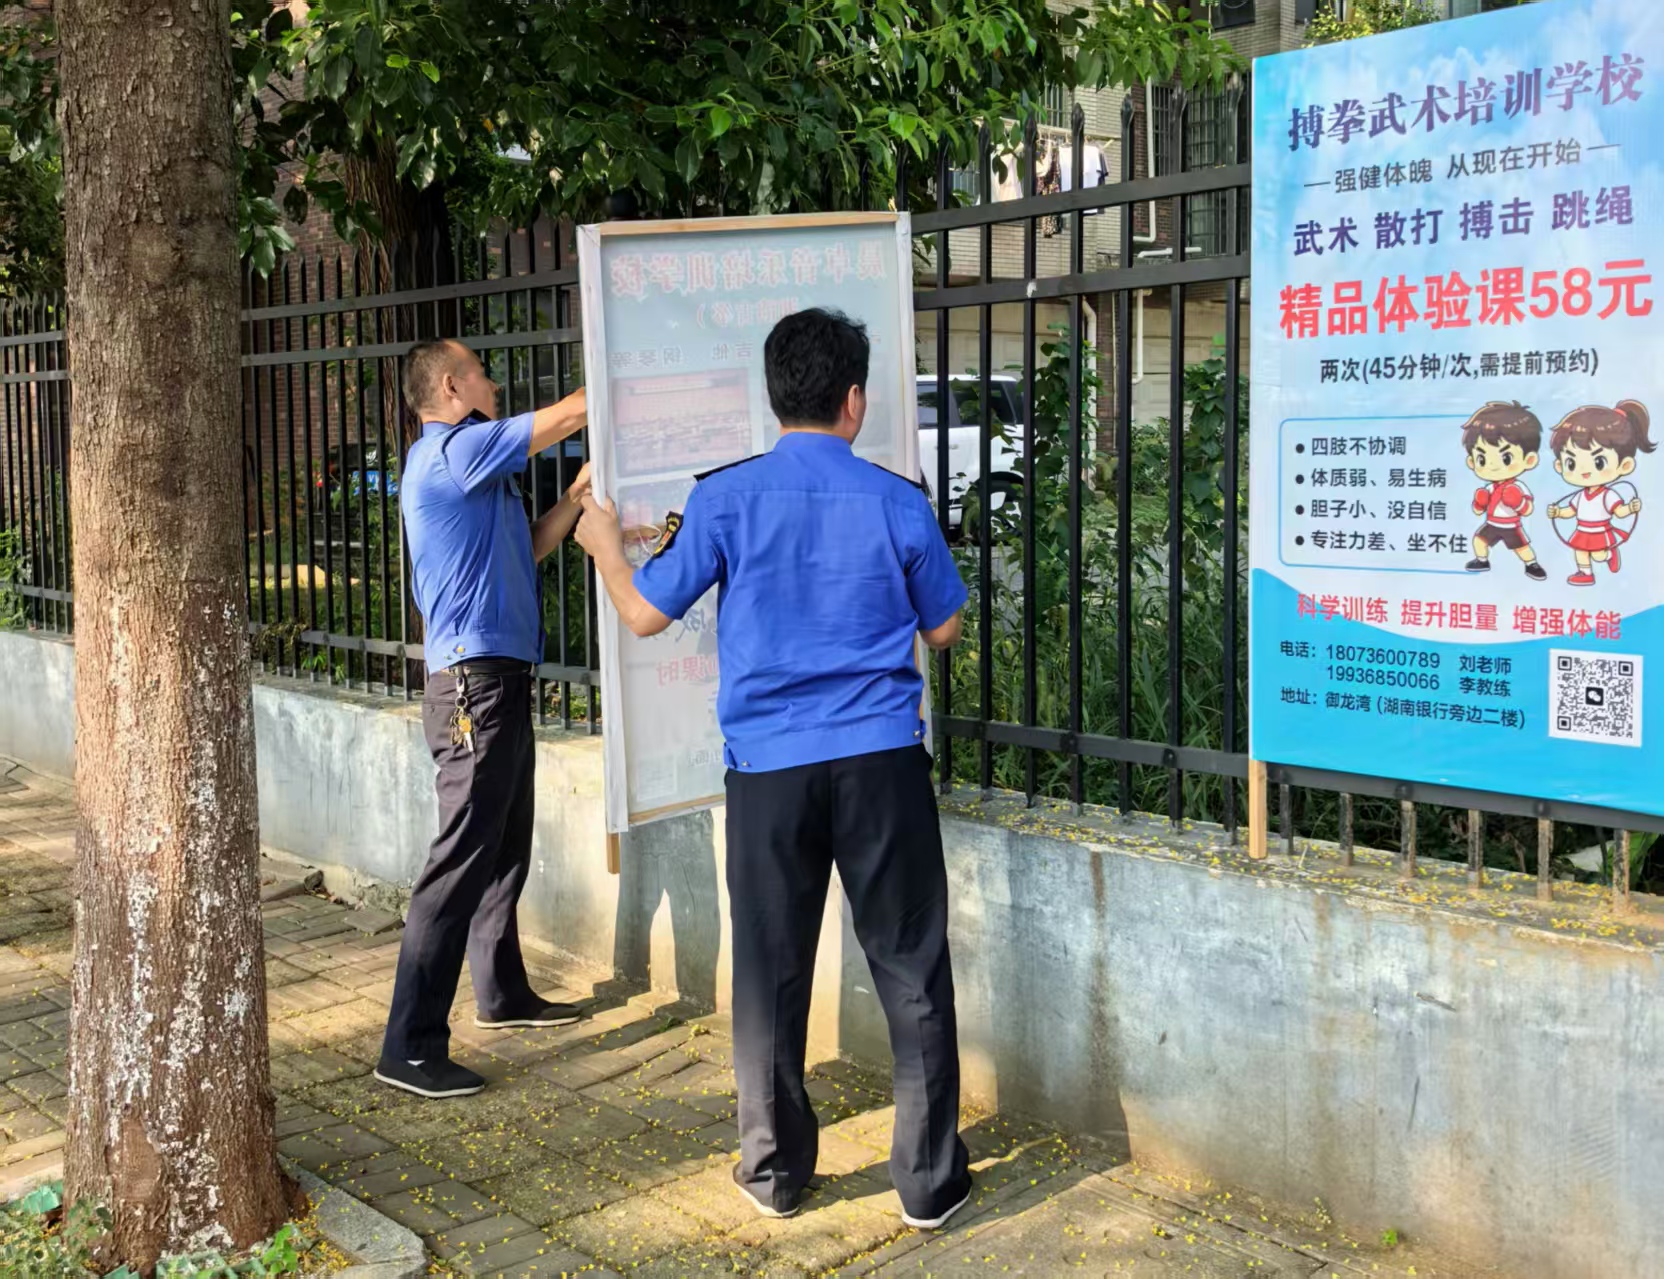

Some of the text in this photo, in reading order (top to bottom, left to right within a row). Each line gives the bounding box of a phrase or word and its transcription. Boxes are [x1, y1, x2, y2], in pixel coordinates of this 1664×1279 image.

[1288, 53, 1645, 151] 搏拳武术培训学校
[1334, 138, 1582, 193] 强健体魄 从现在开始
[1294, 185, 1633, 257] 武术 散打 搏击 跳绳
[1280, 258, 1653, 340] 精品体验课58元
[1311, 436, 1407, 456] 四肢不协调
[1311, 468, 1447, 488] 体质弱、易生病
[1311, 500, 1447, 521] 胆子小、没自信
[1311, 531, 1468, 554] 专注力差、坐不住
[1297, 593, 1623, 641] 科学训练 提升胆量 增强体能
[1326, 665, 1512, 698] 19936850066 李教练
[1458, 655, 1512, 675] 刘老师
